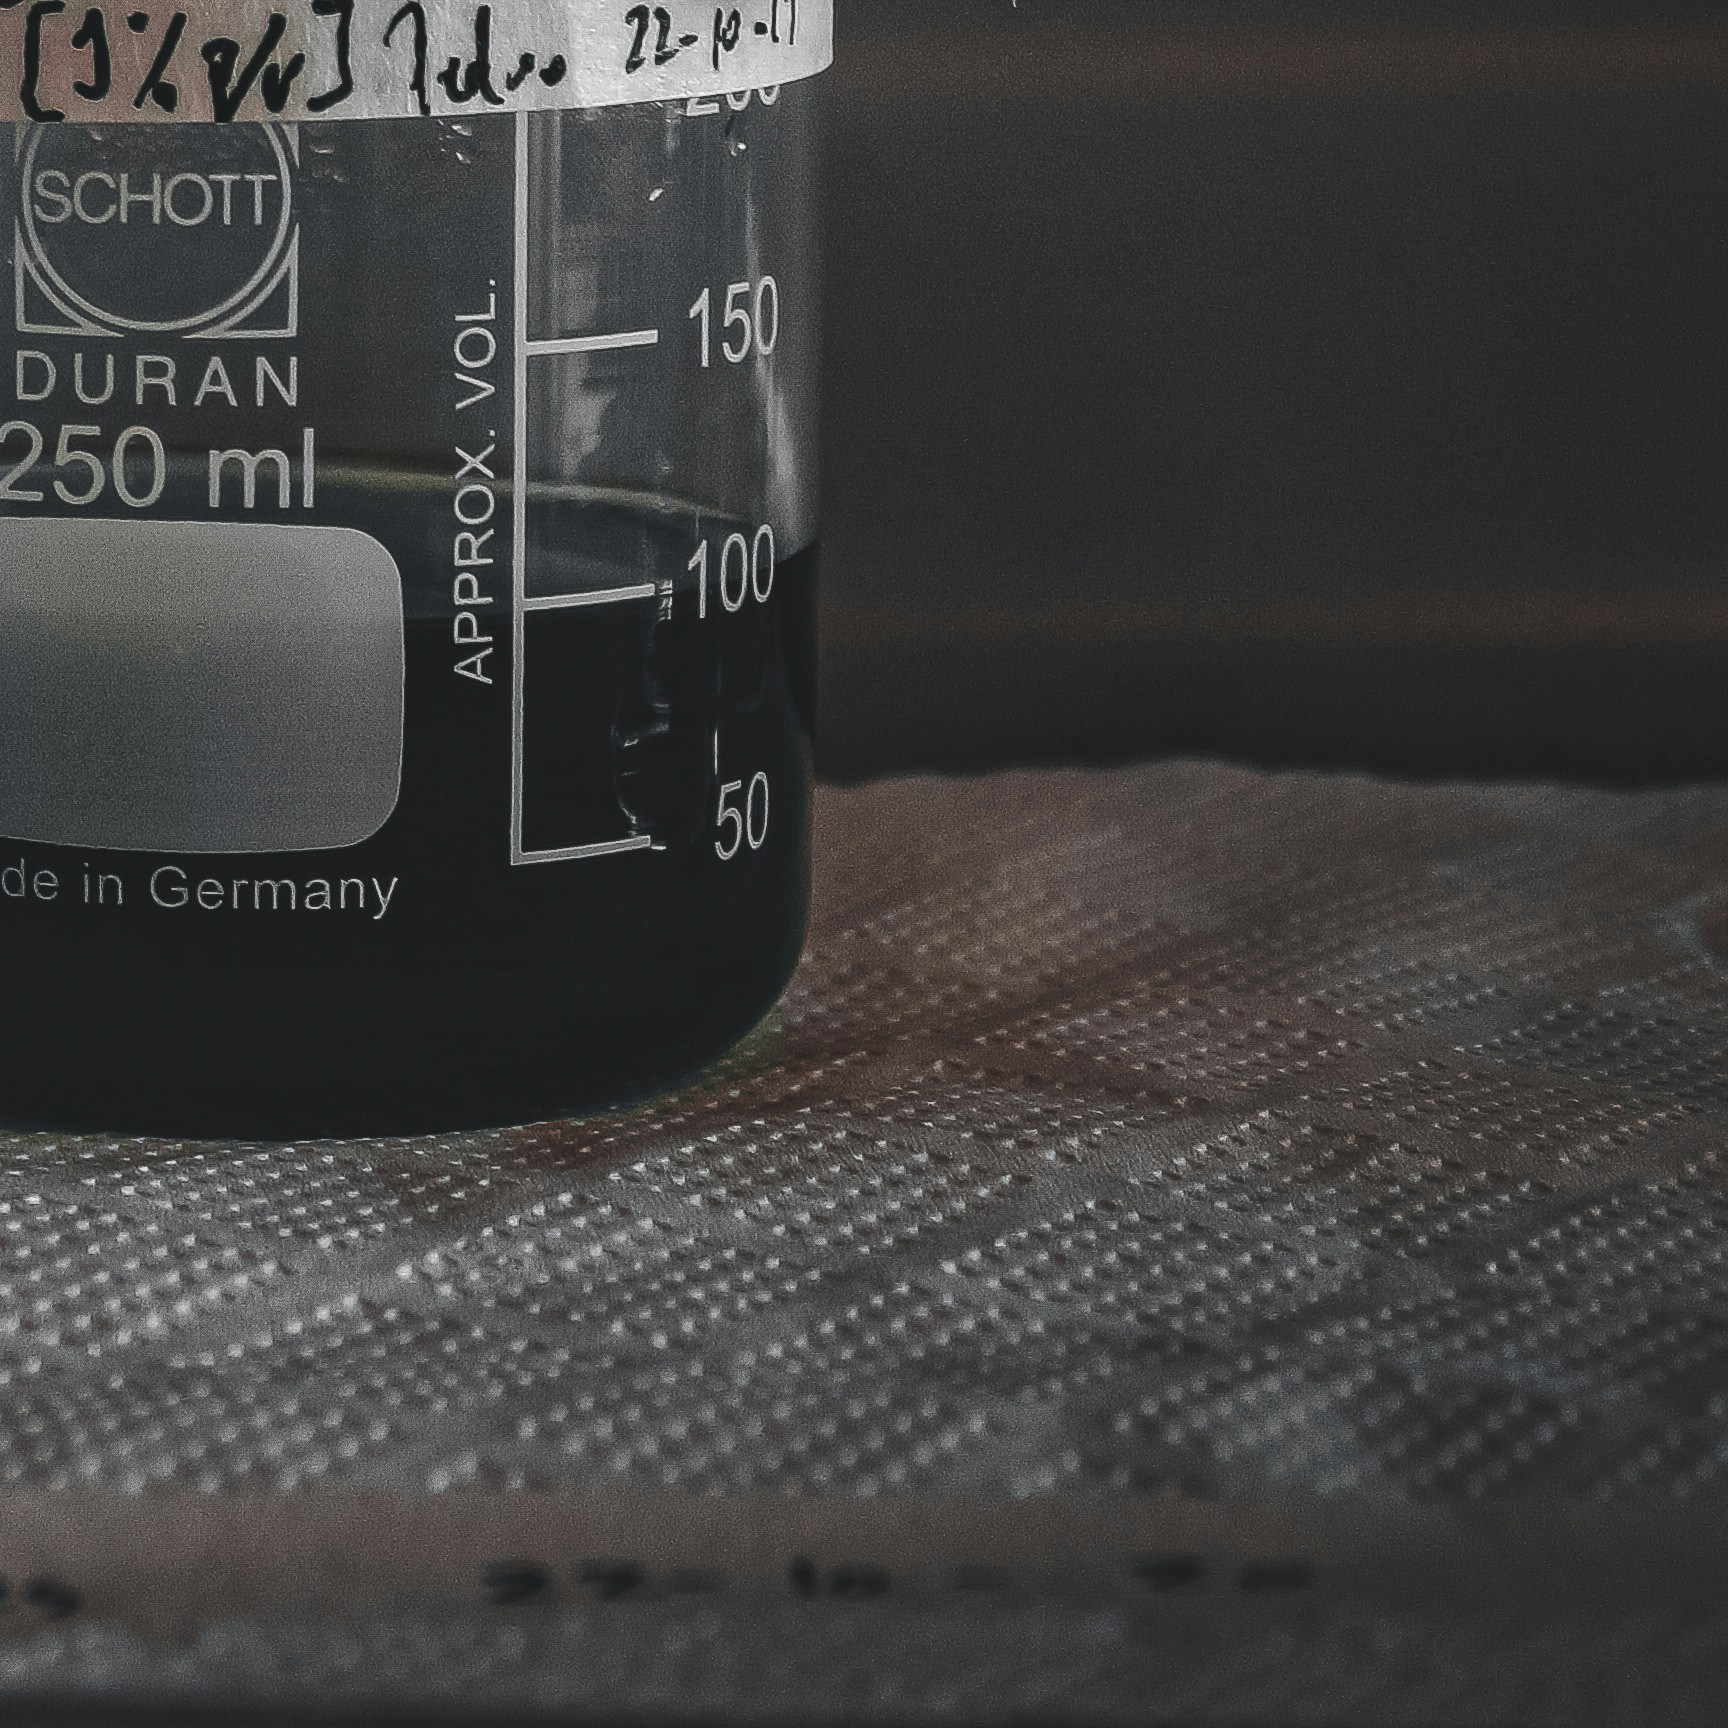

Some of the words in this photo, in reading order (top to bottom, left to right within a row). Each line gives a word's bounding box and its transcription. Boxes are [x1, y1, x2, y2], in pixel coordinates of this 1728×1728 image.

[32, 169, 279, 227] SCHOTT
[452, 277, 499, 411] VOL.
[687, 274, 780, 369] 150
[14, 349, 299, 408] DURAN
[208, 426, 316, 509] ml
[452, 427, 497, 686] APPROX.
[687, 523, 775, 620] 100
[714, 771, 771, 862] 50
[83, 862, 124, 906] in
[149, 864, 400, 921] Germany
